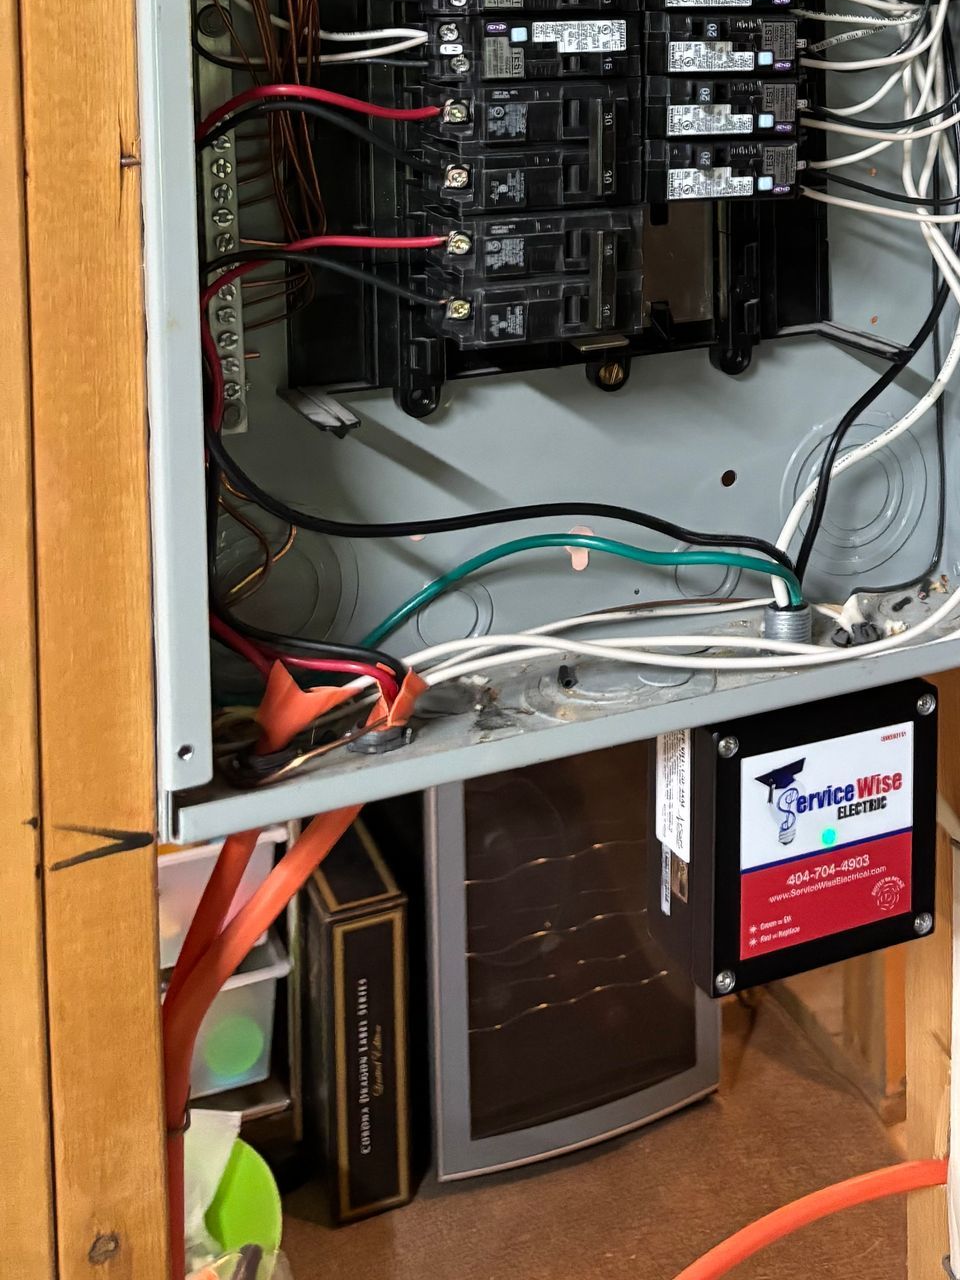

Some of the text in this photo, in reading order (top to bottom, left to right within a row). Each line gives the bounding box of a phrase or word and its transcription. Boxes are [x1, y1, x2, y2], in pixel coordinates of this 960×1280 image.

[707, 24, 718, 37] 20
[700, 88, 710, 101] 20
[604, 113, 612, 126] 30
[700, 152, 711, 165] 20
[604, 170, 612, 184] 30
[777, 772, 903, 831] Service Wise
[837, 795, 887, 820] ELECTRIC
[786, 854, 870, 886] 404-704-4903
